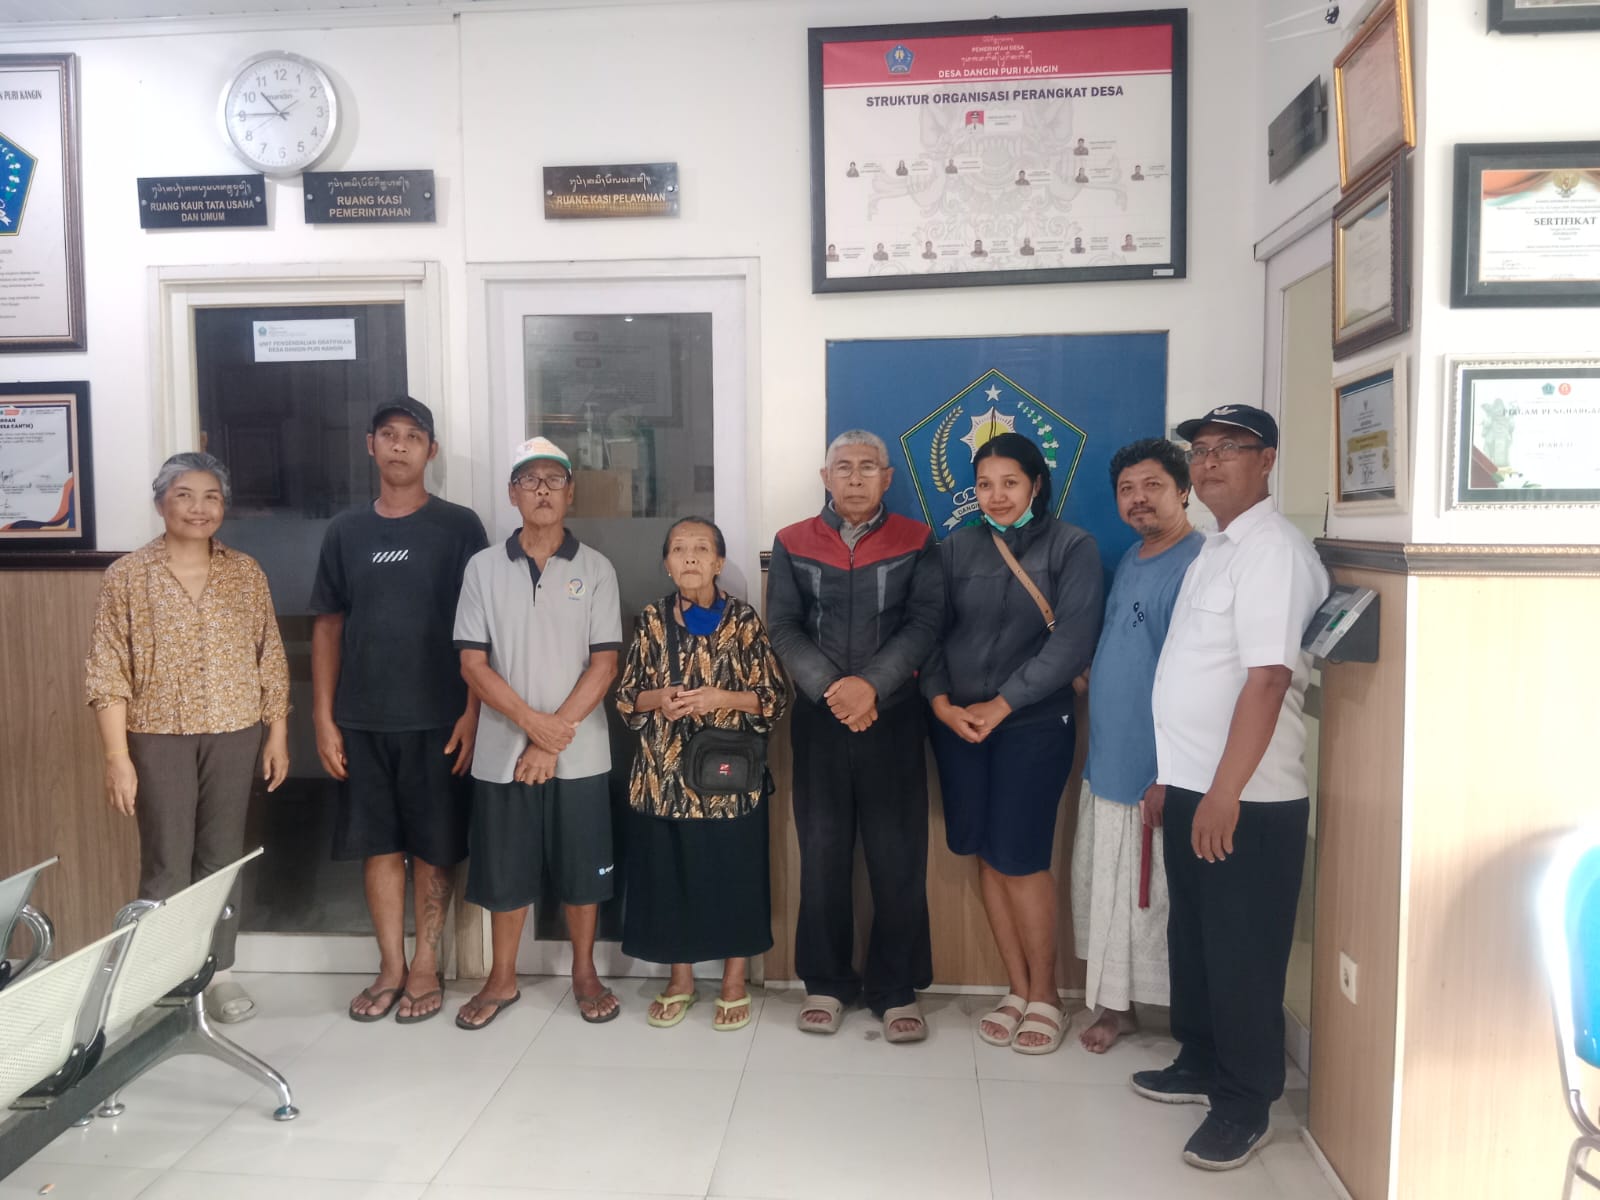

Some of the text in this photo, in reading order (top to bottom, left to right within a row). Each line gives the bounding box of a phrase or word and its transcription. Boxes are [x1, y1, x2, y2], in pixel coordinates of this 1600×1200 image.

[274, 68, 287, 80] 12
[938, 65, 1058, 78] DESA DANGIN PURI KANGIN
[256, 76, 266, 87] 11
[296, 73, 301, 84] 1
[243, 92, 256, 103] 10
[310, 86, 317, 98] 2
[866, 86, 1124, 107] STRUKTUR ORGANISASI PERANGKAT DESA
[239, 110, 246, 122] 9
[316, 107, 324, 118] 3
[245, 130, 253, 141] 8
[311, 126, 318, 137] 4
[260, 143, 267, 154] 7
[297, 141, 304, 152] 5
[279, 147, 286, 159] 6
[337, 195, 402, 206] RUANG KASI
[556, 193, 666, 205] RUANG KASI PELAYANAN
[150, 199, 254, 211] RUANG KAUR TATA USAHA
[181, 212, 225, 222] DAN UMUM
[329, 207, 411, 217] PEMERINTAHAN
[1534, 216, 1597, 226] SERTIFIKAT
